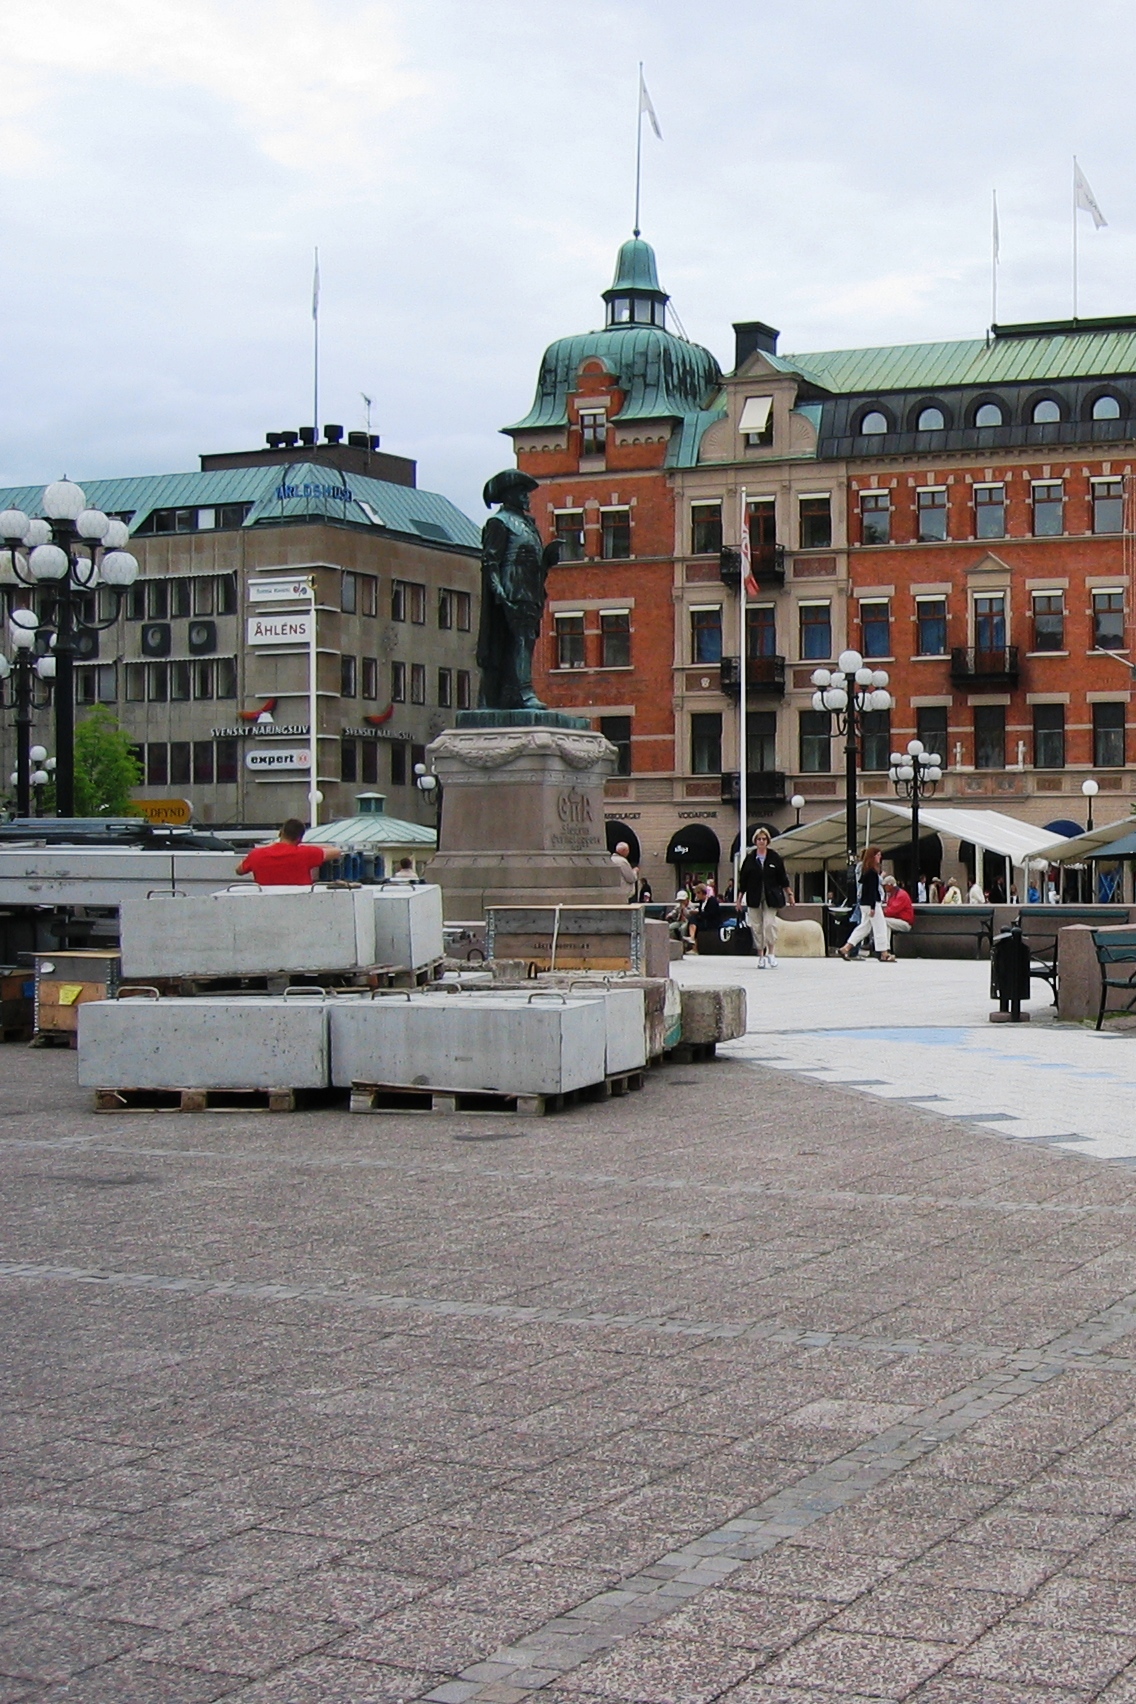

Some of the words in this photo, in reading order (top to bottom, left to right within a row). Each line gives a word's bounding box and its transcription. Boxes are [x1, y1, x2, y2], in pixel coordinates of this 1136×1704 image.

[254, 621, 306, 636] ÅHLÉNS
[210, 726, 250, 737] SVENSKT
[251, 754, 294, 765] expert
[678, 811, 718, 819] VODAFONE
